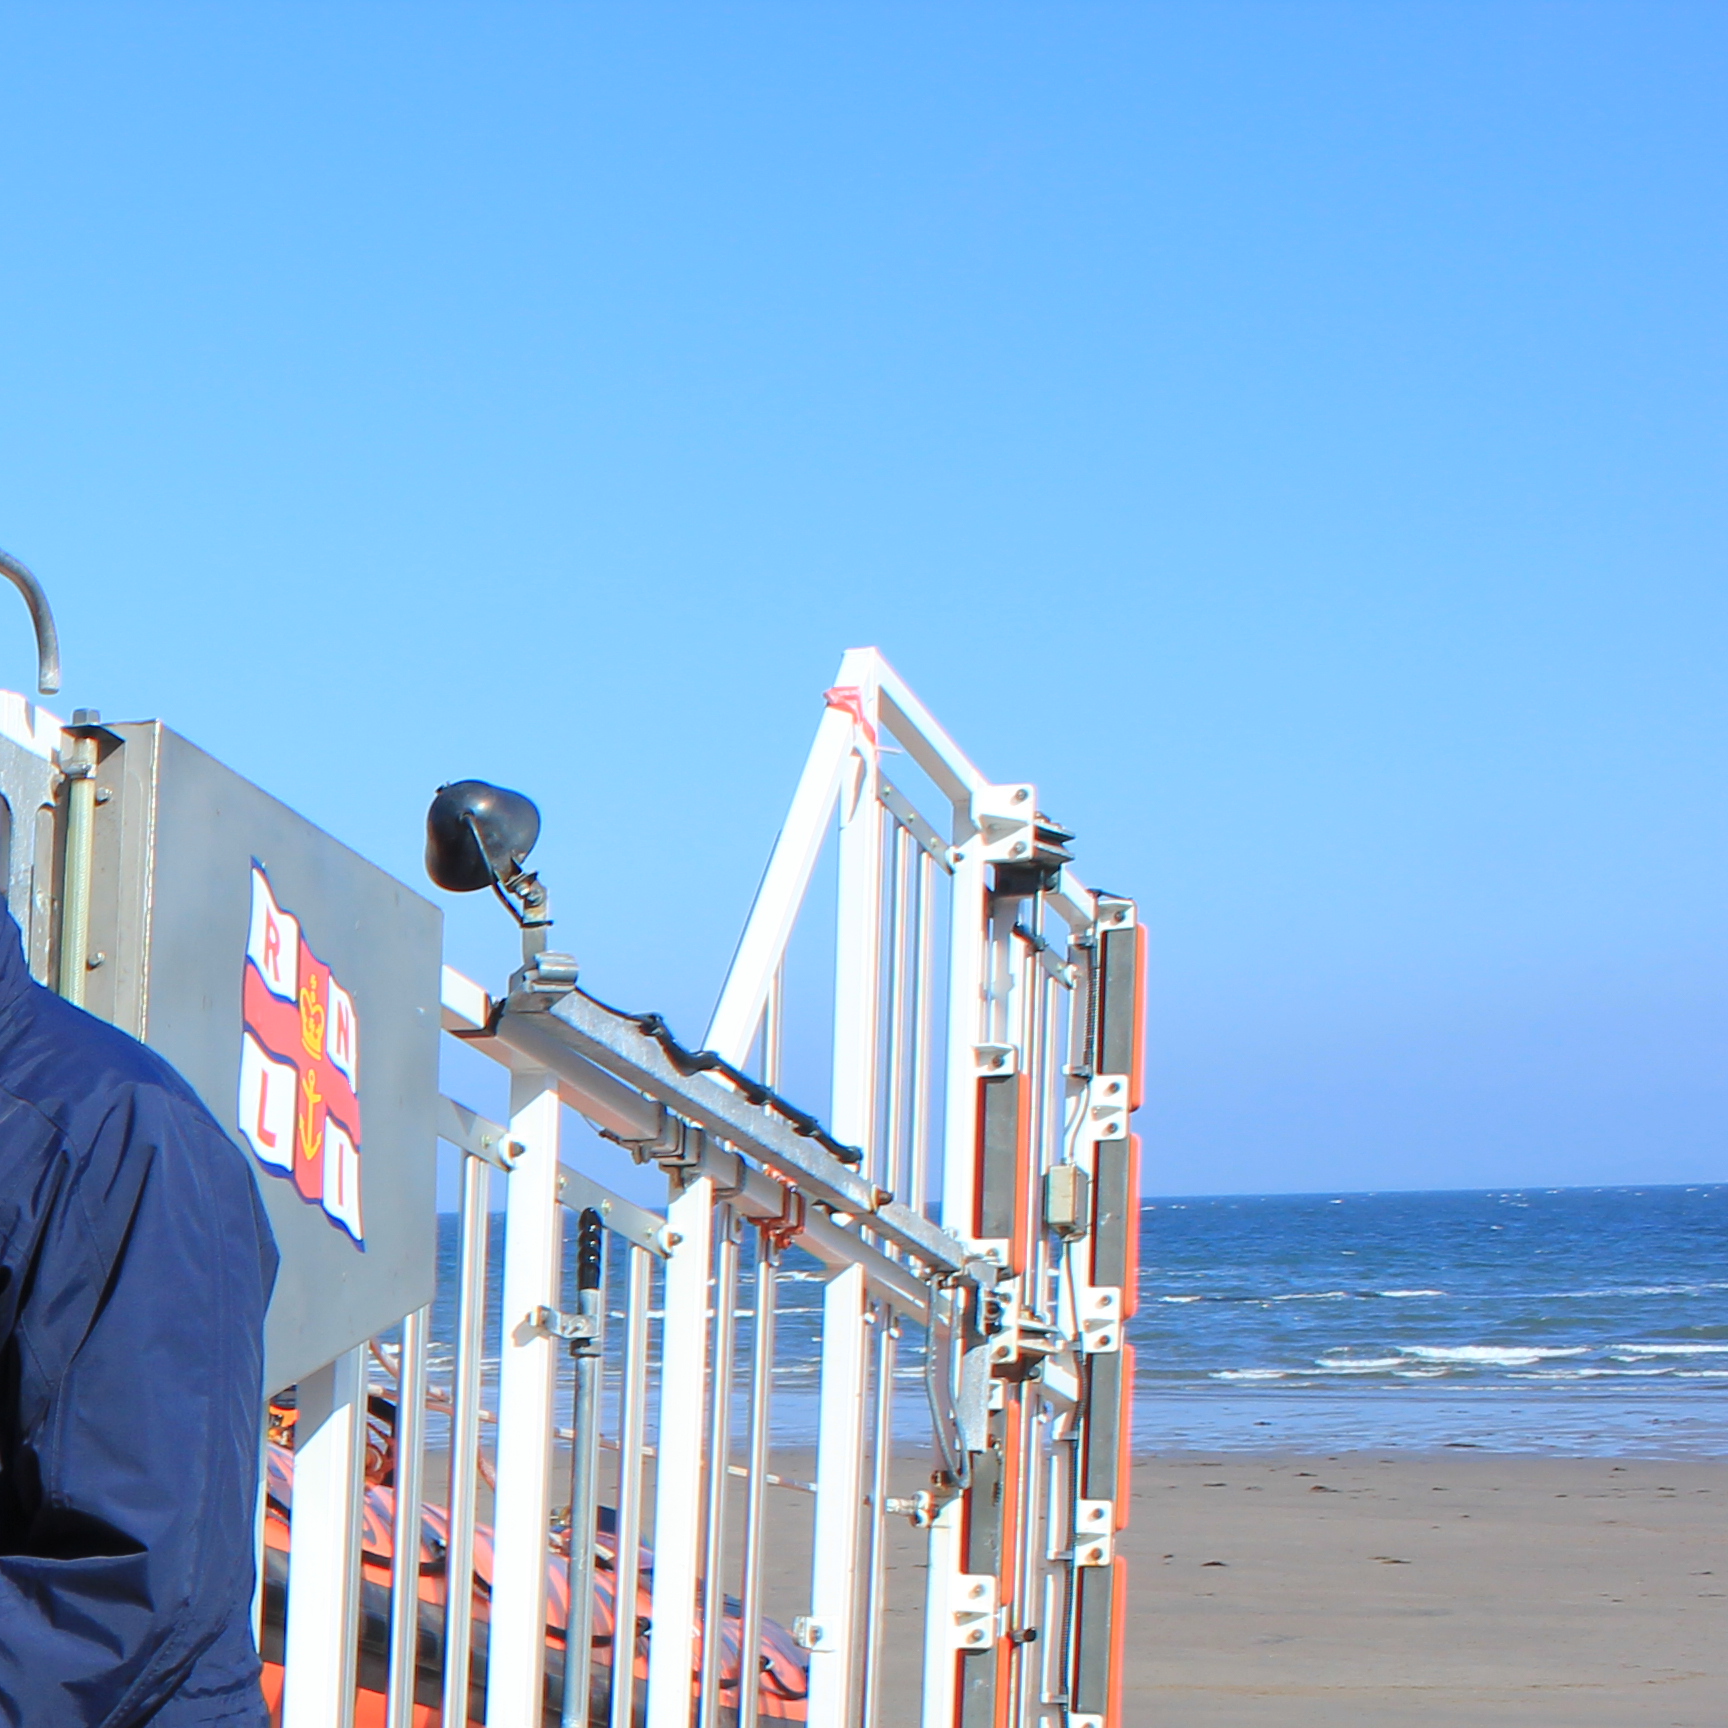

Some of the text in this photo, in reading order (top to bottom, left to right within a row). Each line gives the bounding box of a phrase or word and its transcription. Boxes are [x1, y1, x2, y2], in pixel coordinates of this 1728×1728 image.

[263, 903, 351, 1062] R N
[256, 1067, 277, 1149] L
